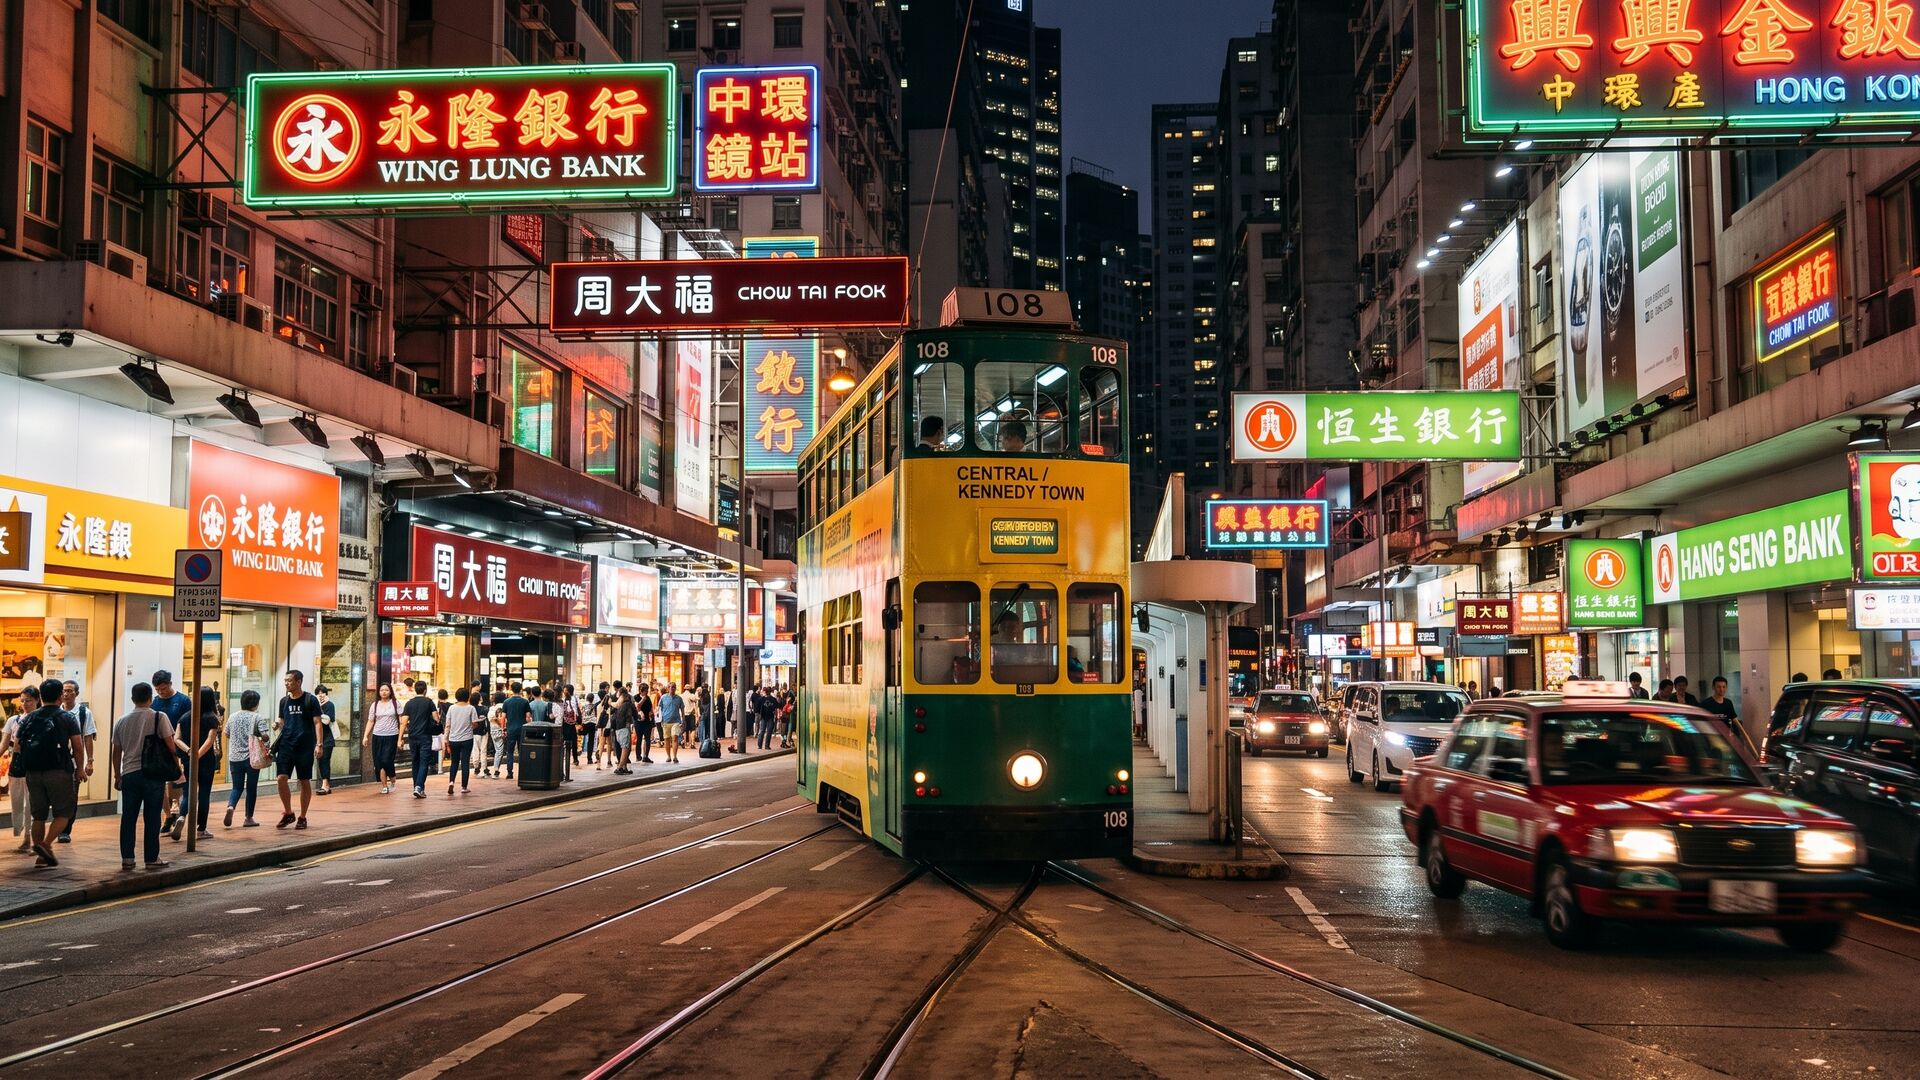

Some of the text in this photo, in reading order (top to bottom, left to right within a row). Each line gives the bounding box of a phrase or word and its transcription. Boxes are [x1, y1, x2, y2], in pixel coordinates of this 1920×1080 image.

[708, 76, 808, 123] 中環
[1755, 76, 1845, 104] HONG
[376, 87, 648, 153] 永隆銀行
[286, 104, 347, 171] 永
[377, 153, 647, 183] WING LUNG BANK
[706, 131, 808, 179] 鏡站
[573, 274, 713, 317] 周大福
[738, 284, 887, 301] CHOW TAI FOOK
[983, 291, 1045, 317] 108
[1792, 314, 1805, 335] TAI
[1807, 302, 1830, 328] FOOK
[916, 342, 949, 359] 108
[1091, 346, 1117, 365] 108
[1316, 405, 1509, 446] 恒生銀行
[957, 466, 1038, 481] CENTRAL
[958, 485, 1085, 501] KENNEDY TOWN
[56, 511, 133, 560] 永隆銀
[231, 493, 326, 555] 永隆銀行
[993, 535, 1054, 546] KENNEDY TOWN
[1680, 513, 1844, 582] HANG SENG BANK
[231, 548, 324, 578] WING LUNG BANK
[434, 543, 507, 605] 周大福
[518, 576, 543, 595] CHOW
[545, 581, 559, 597] TAI
[1574, 594, 1637, 609] 恒生銀行
[1574, 610, 1595, 618] HANG
[1104, 810, 1128, 828] 108
